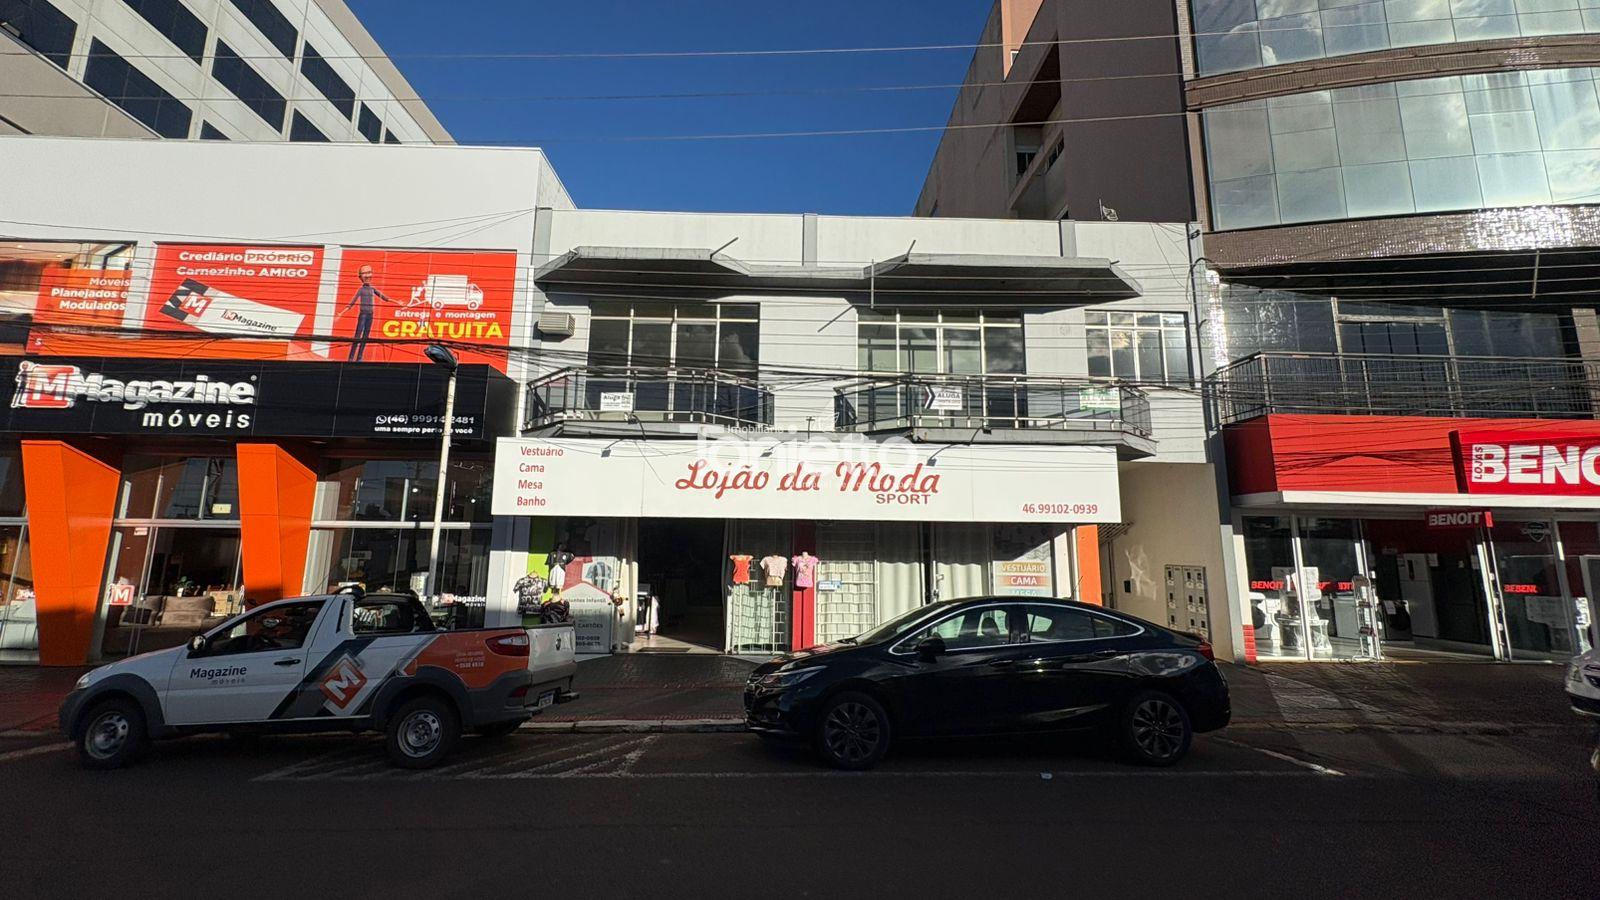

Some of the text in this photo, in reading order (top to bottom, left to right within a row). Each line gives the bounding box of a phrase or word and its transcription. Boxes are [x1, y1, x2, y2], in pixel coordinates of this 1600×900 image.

[179, 250, 312, 263] Crediário PRÓPRIO
[176, 266, 308, 278] Carnezinho AMIGO
[89, 277, 131, 287] Móveis
[51, 288, 117, 299] Planejados
[59, 300, 126, 311] Modulados
[445, 311, 496, 320] montagem
[382, 320, 504, 339] GRATUITA
[142, 410, 251, 428] móveis
[520, 445, 564, 456] Vestuário
[519, 462, 545, 473] Cama
[1473, 446, 1484, 480] LOJAS
[517, 479, 543, 489] Mesa
[675, 458, 941, 499] Lojão da Moda
[517, 496, 546, 506] Banho
[875, 493, 932, 505] SPORT
[1022, 503, 1098, 515] 46.99102-0939
[1428, 511, 1483, 526] BENOIT
[1002, 562, 1046, 573] VESTUÁRIO
[1010, 576, 1038, 585] CAMA
[189, 665, 247, 680] Magazine
